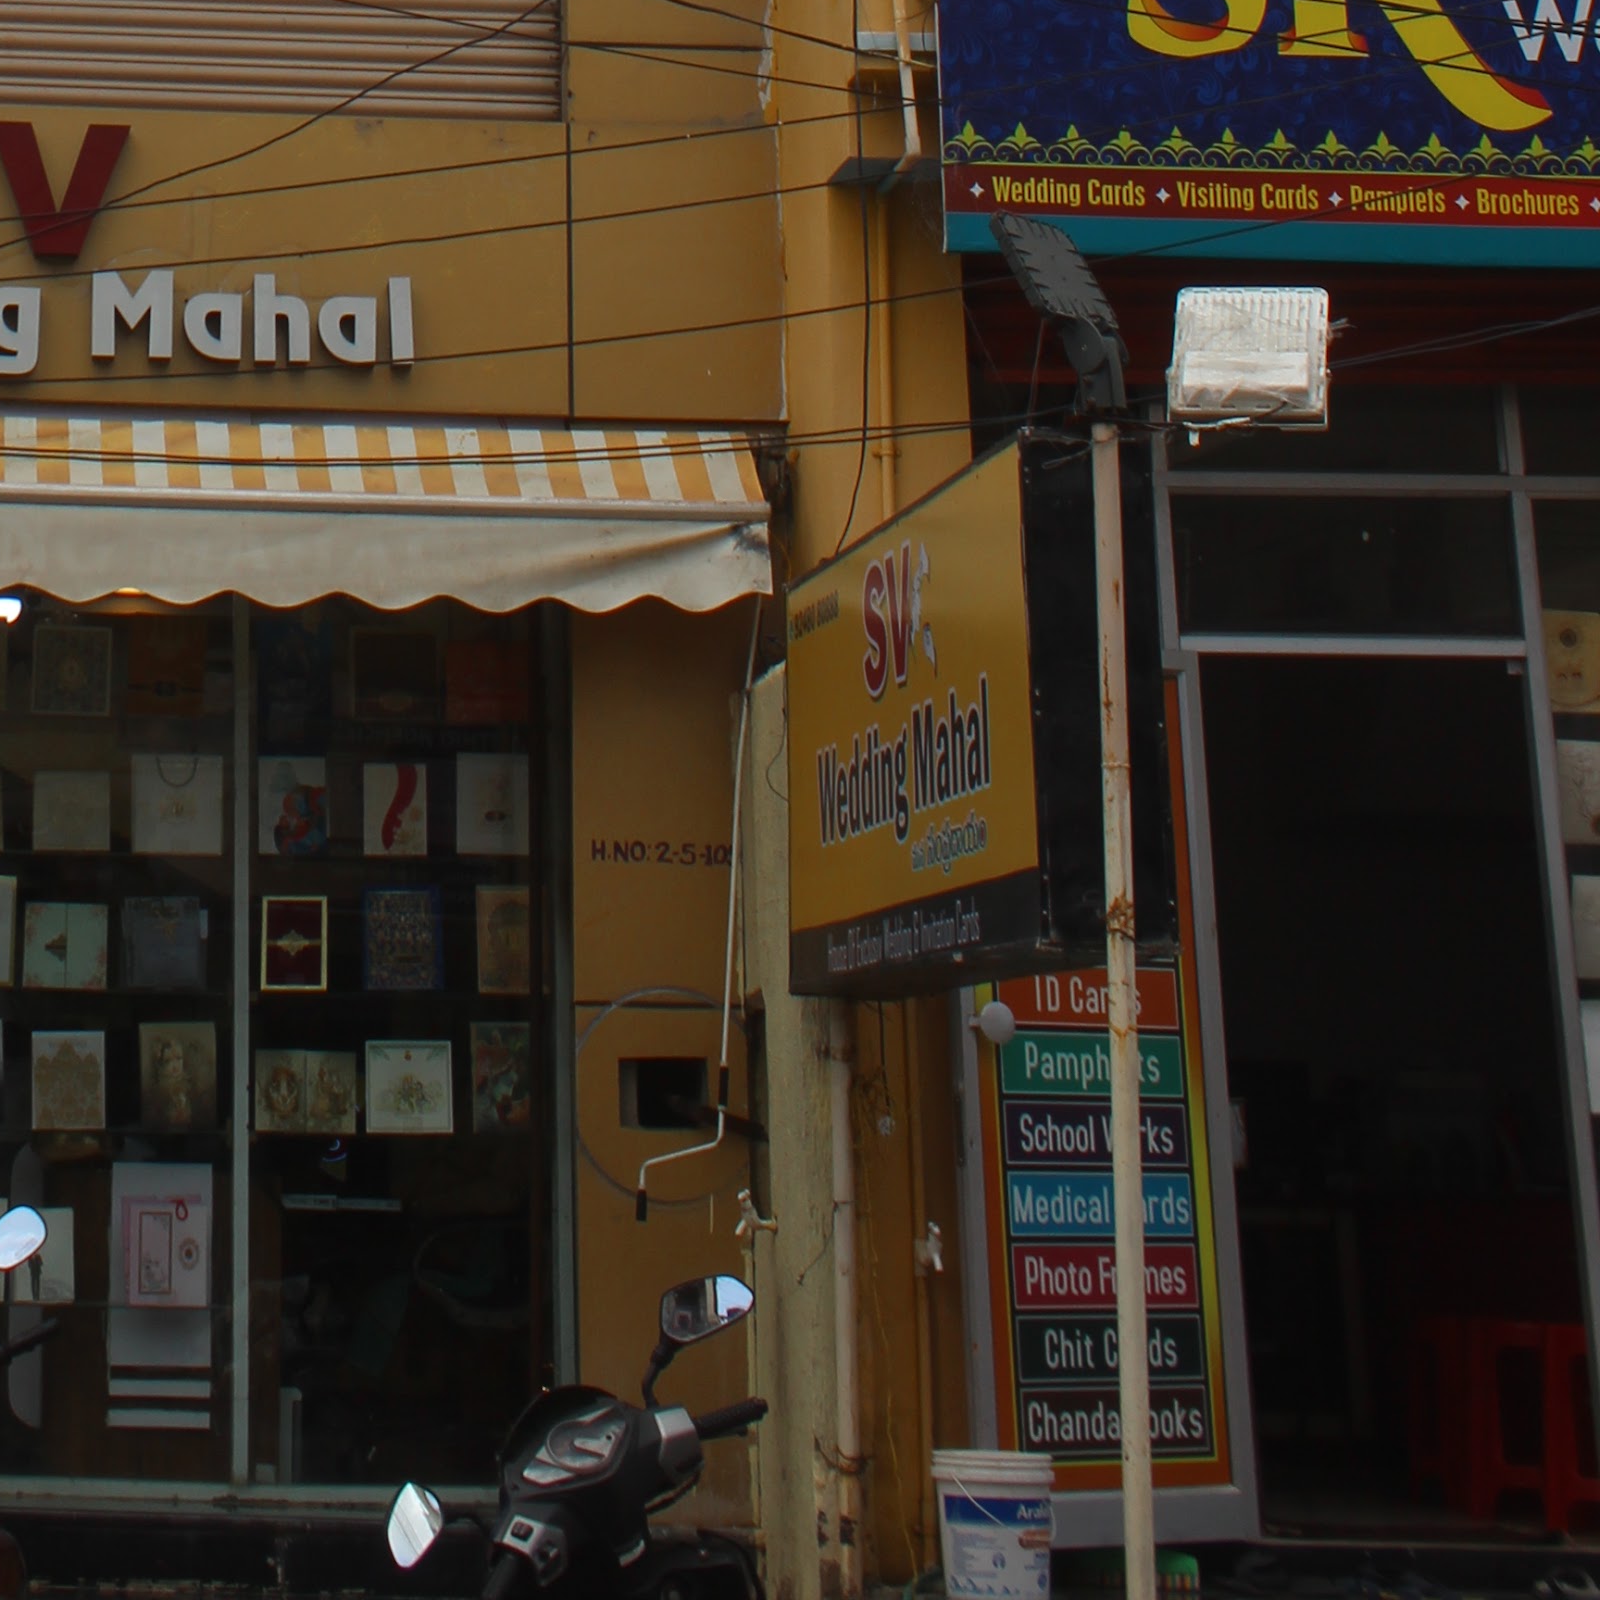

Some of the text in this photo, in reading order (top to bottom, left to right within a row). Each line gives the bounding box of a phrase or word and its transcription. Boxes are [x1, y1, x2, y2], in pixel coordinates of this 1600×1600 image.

[992, 175, 1081, 207] Wedding
[1087, 177, 1146, 208] Cards
[1176, 180, 1256, 212] Visiting
[1261, 182, 1320, 212] Cards
[1475, 188, 1581, 216] Brochures
[90, 268, 415, 367] Mahal
[862, 539, 912, 701] SV
[816, 673, 992, 844] Wedding Mahal
[1069, 975, 1142, 1016] Cars
[1023, 1039, 1161, 1092] Pamphts
[1018, 1112, 1097, 1154] School
[1012, 1184, 1111, 1225] Medical
[1023, 1255, 1188, 1297] Photo Frmes
[1043, 1326, 1179, 1370] Chit Cds
[1027, 1397, 1204, 1444] Chanda ooks
